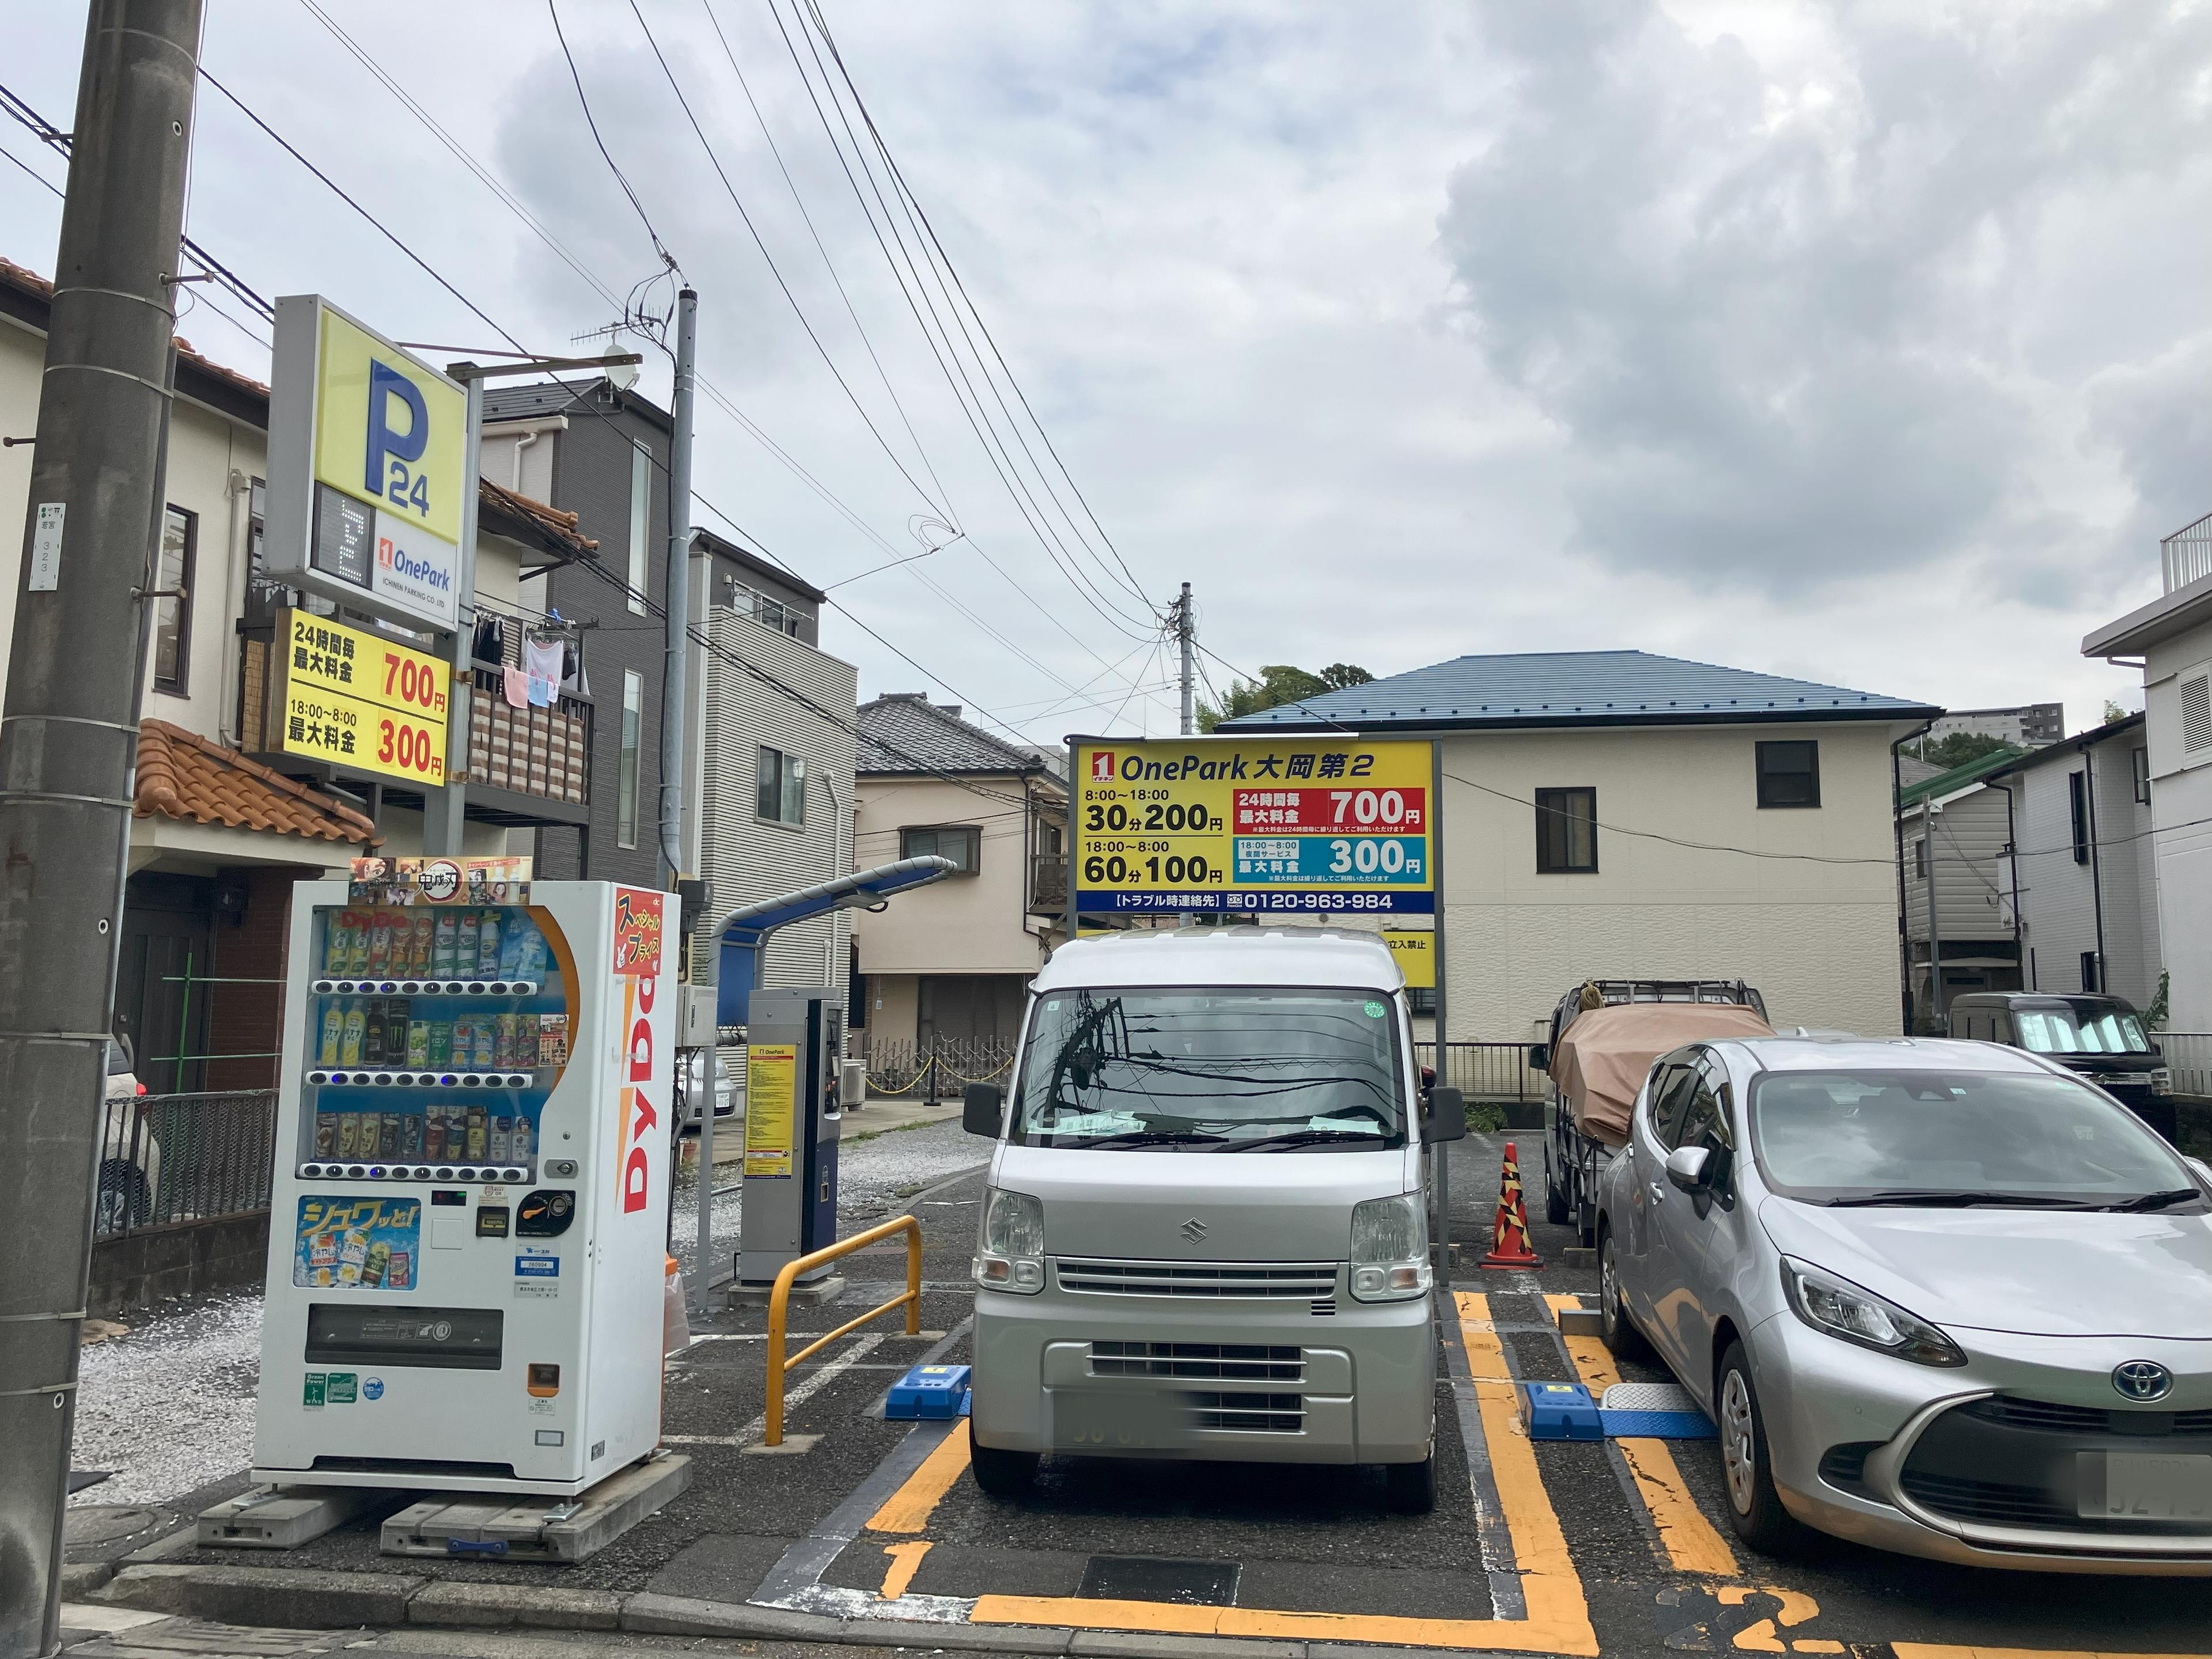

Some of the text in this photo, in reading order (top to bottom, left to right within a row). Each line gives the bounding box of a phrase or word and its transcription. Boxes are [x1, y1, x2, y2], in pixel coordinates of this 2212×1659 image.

[365, 357, 429, 497] P
[389, 461, 430, 517] 24
[41, 542, 50, 572] 323
[395, 550, 450, 592] OnePark
[382, 577, 404, 592] ICHINEN
[404, 586, 426, 600] PARKING
[294, 621, 355, 660] 24時間毎
[293, 646, 353, 684] 最大料金
[384, 652, 445, 713] 700円
[288, 715, 356, 755] 最大料金
[377, 719, 442, 777] 300円
[1121, 753, 1374, 781] OnePark 大岡第2
[1238, 793, 1300, 807] 24時間毎
[1239, 809, 1300, 824] 最大料金
[1330, 790, 1421, 824] 700円
[1238, 861, 1300, 873] 最大料金
[1328, 839, 1421, 874] 300円
[418, 873, 460, 891] 鬼滅の刃
[618, 893, 661, 935] スペシャル
[1244, 893, 1393, 909] 0120-963-984
[628, 930, 660, 964] プライス
[1387, 940, 1426, 949] 立入禁止
